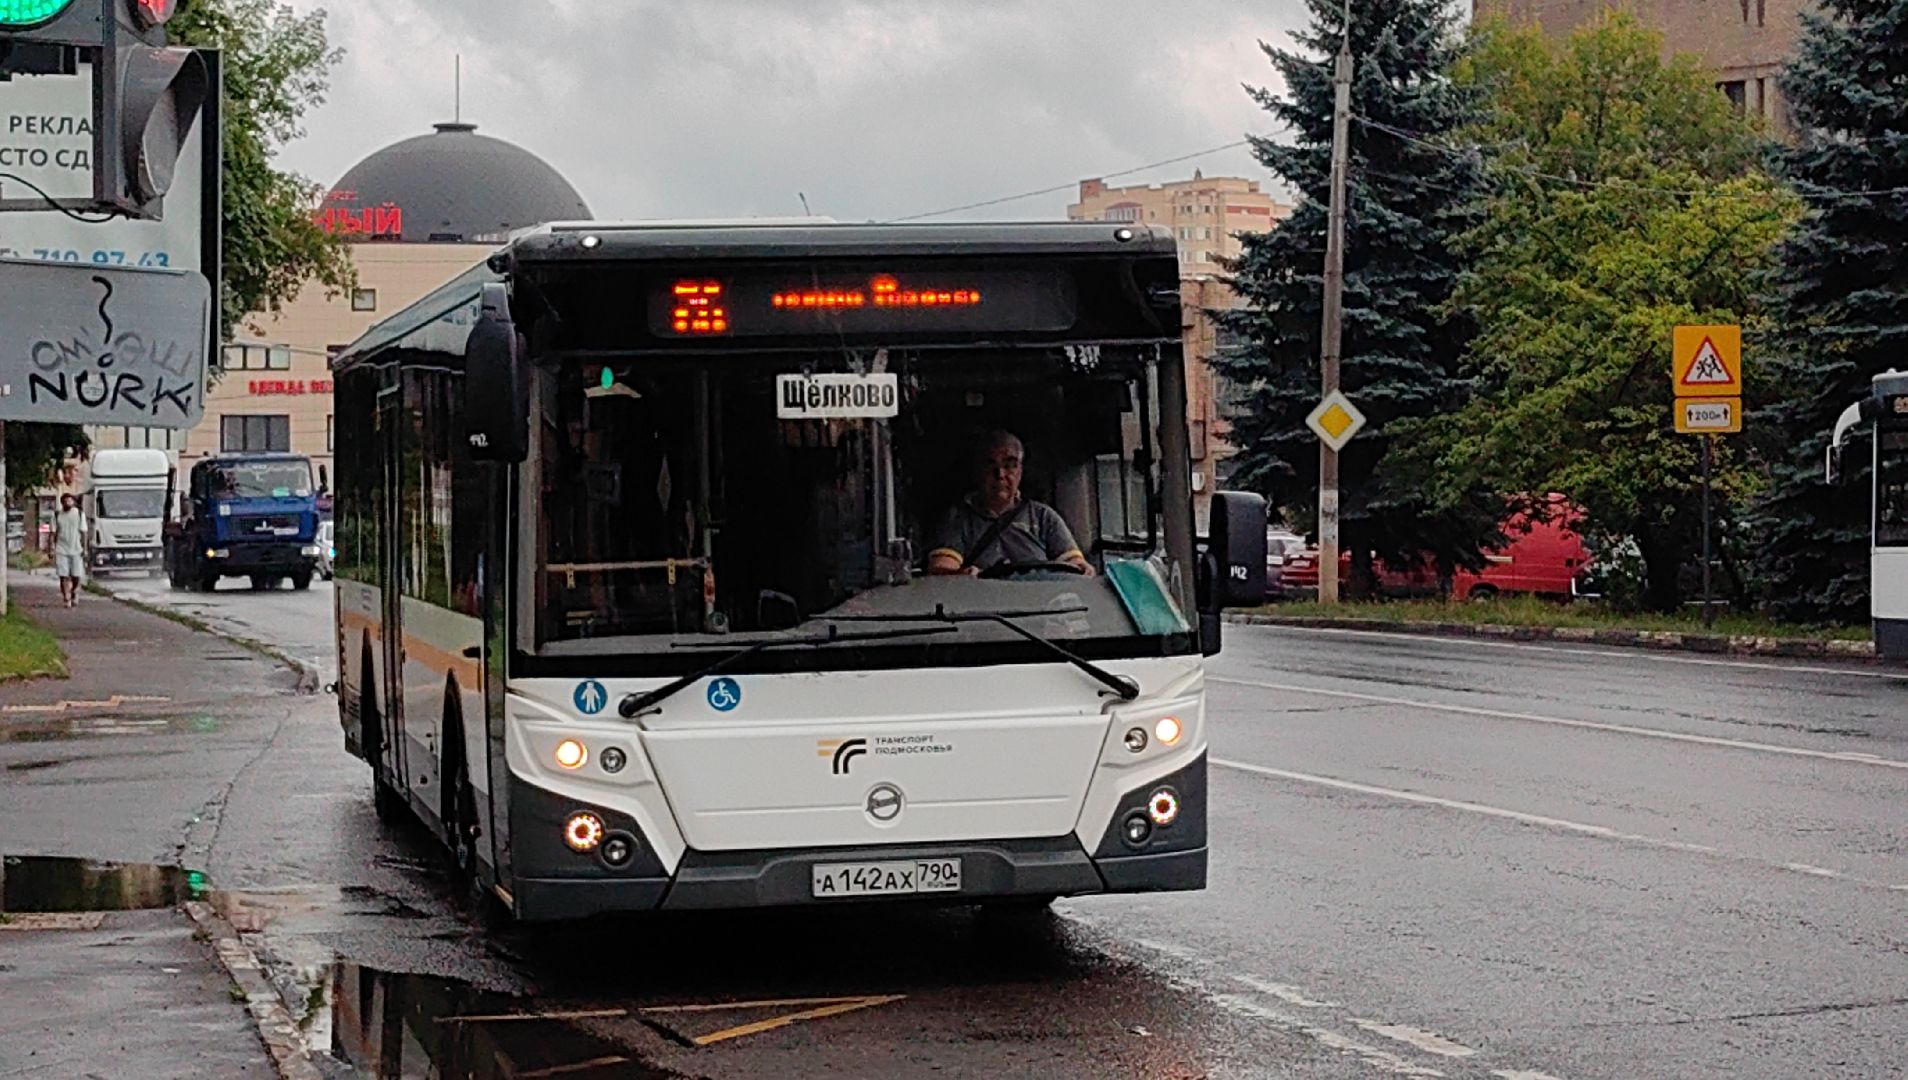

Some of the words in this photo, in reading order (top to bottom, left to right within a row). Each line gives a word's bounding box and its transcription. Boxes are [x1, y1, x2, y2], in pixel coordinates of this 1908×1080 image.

[0, 148, 48, 166] СТО
[783, 379, 895, 412] Щёлково
[875, 735, 934, 745] ТРАНСПОРТ
[875, 745, 953, 755] ПОДМОСКОВЬЯ
[918, 862, 953, 882] 790
